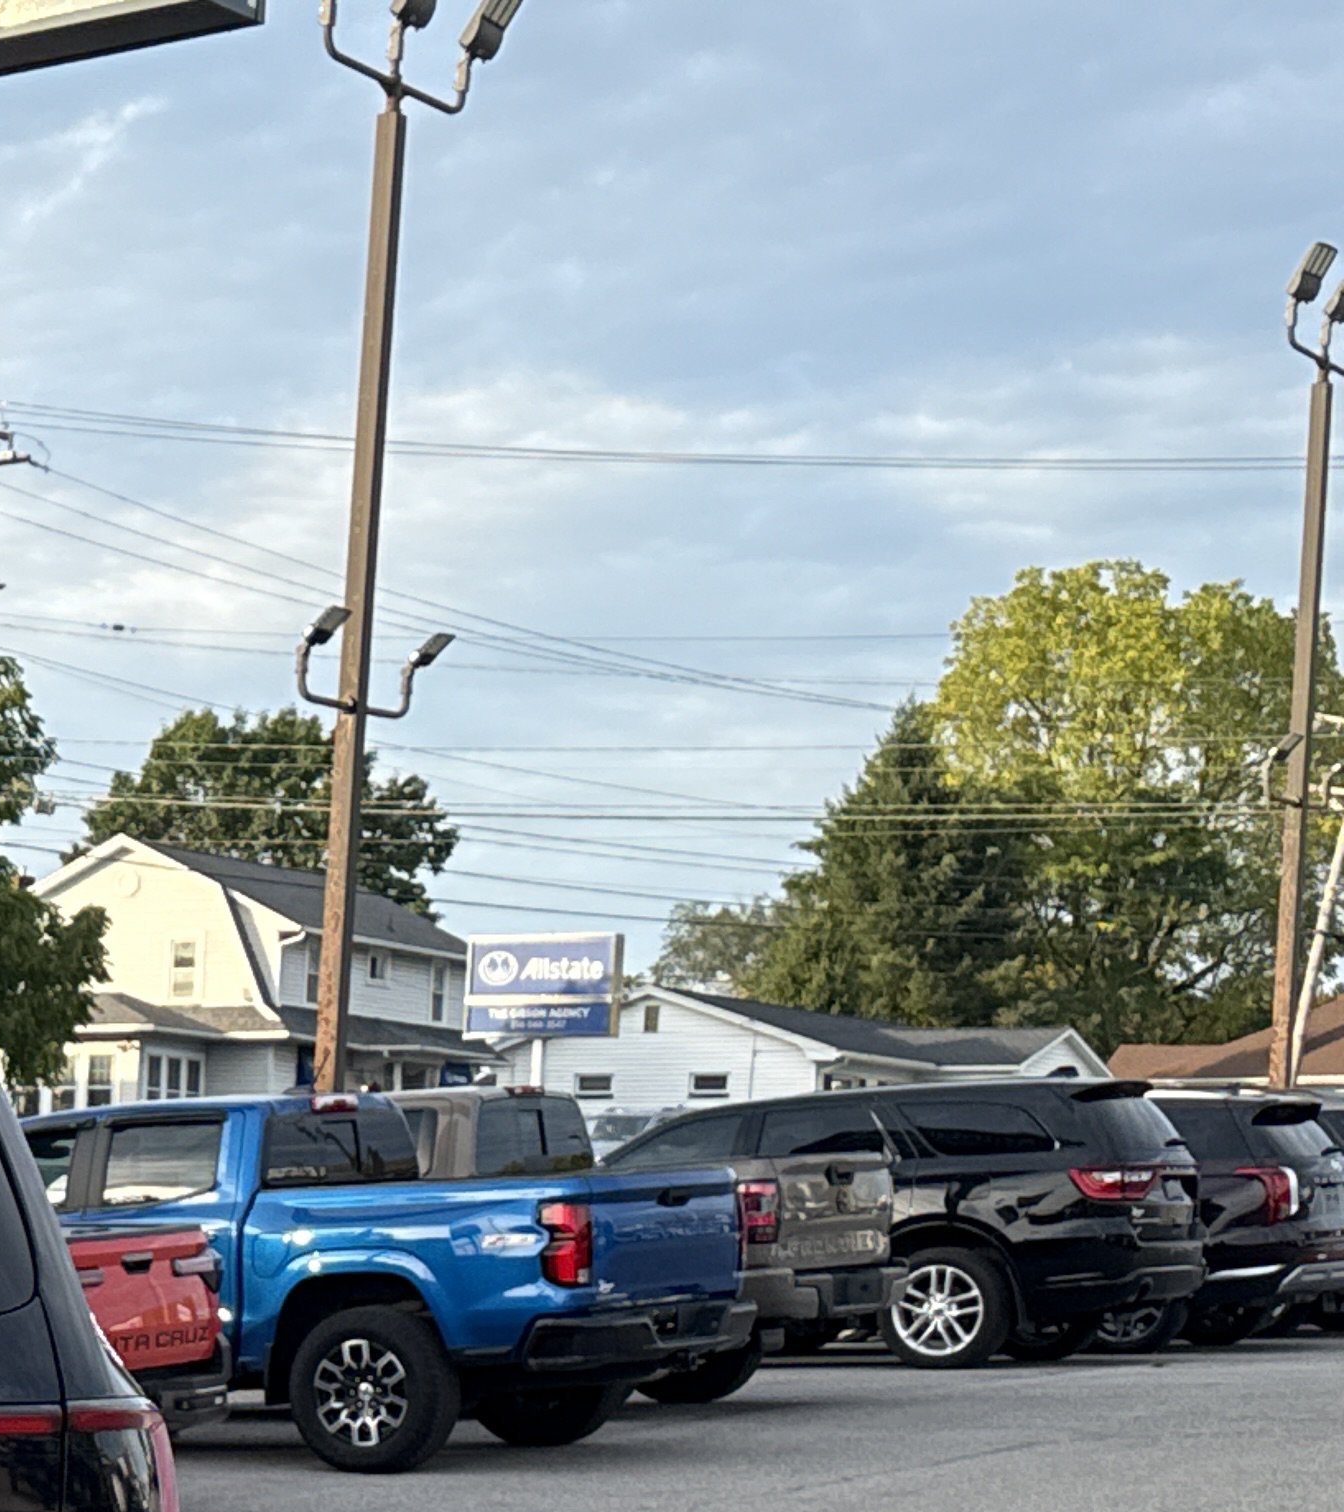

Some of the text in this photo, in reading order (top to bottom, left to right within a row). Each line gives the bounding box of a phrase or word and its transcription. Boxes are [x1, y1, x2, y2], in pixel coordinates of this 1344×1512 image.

[519, 956, 604, 980] Allstate
[549, 1006, 591, 1018] AGENCY
[156, 1327, 209, 1348] CRUZ
